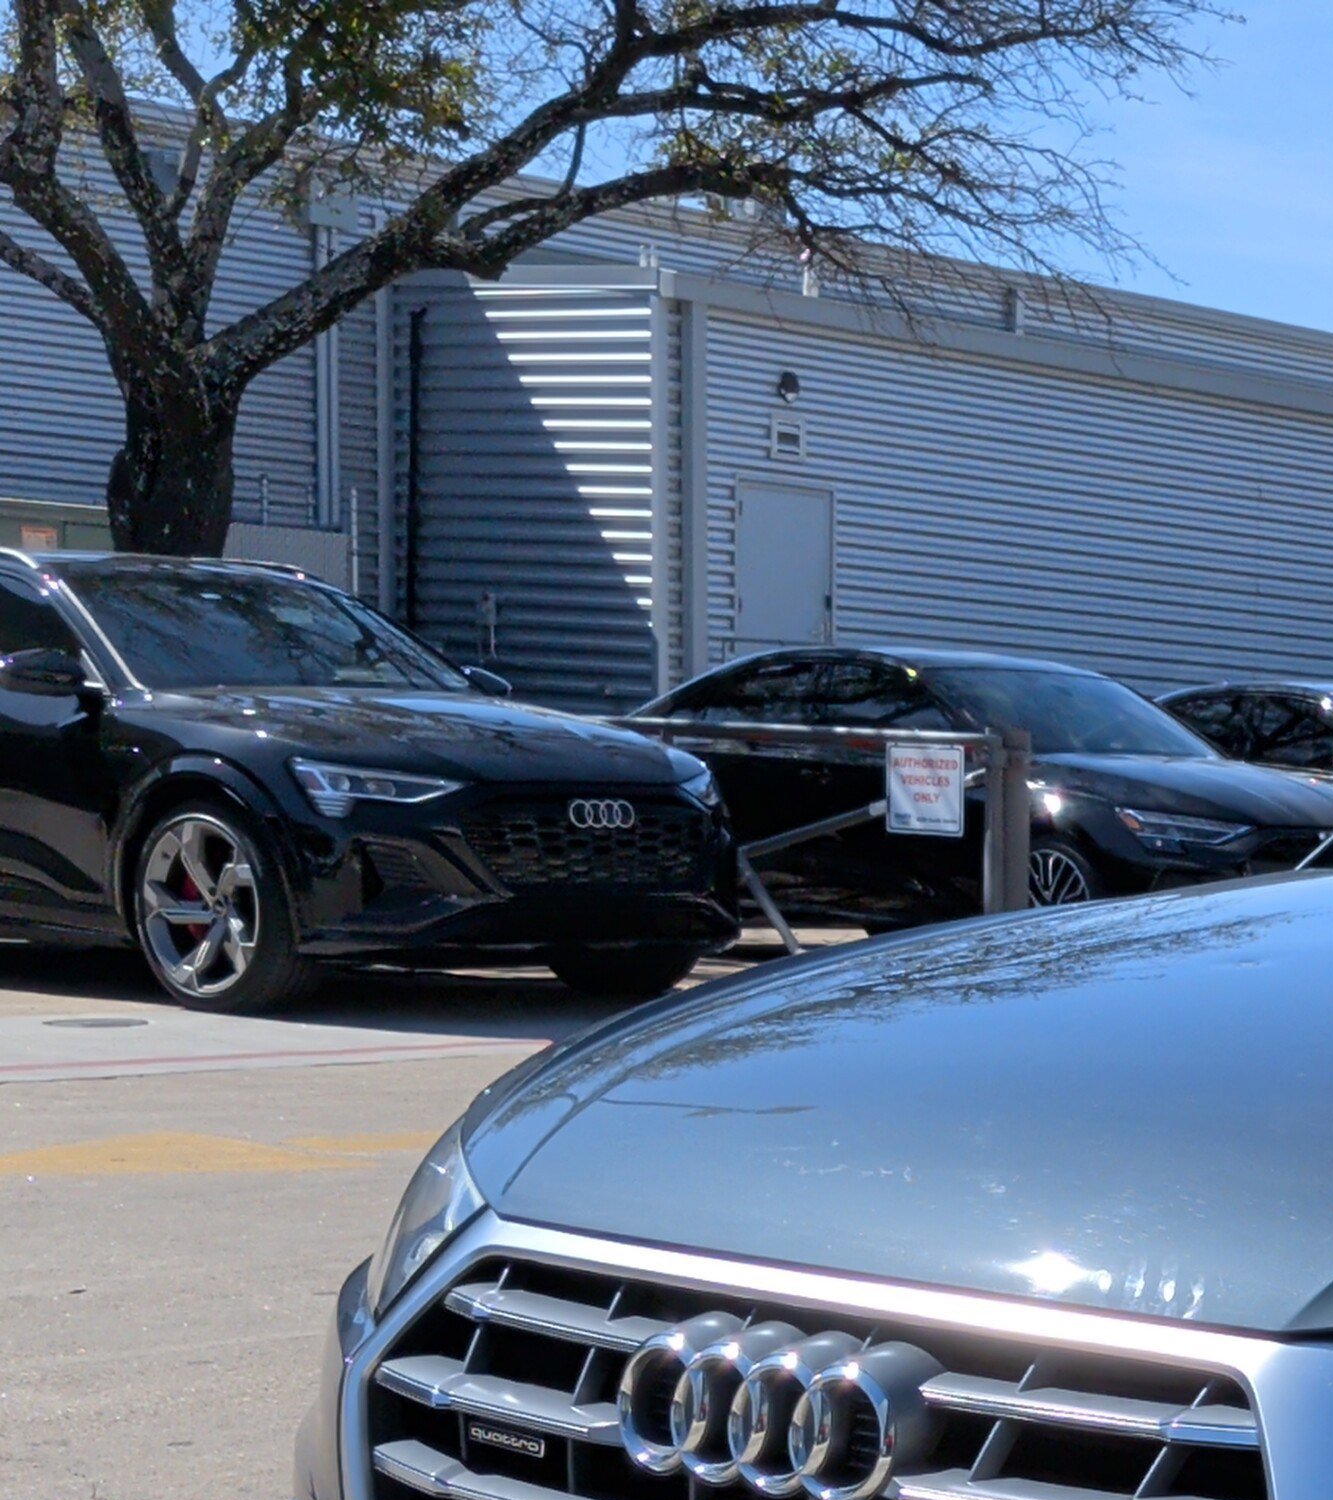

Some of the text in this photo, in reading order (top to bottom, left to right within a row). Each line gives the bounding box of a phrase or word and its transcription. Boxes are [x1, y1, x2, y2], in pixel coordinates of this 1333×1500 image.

[893, 757, 958, 770] AUTHORIZED
[901, 775, 950, 787] VEHICLES
[913, 792, 940, 804] ONLY
[470, 1427, 540, 1452] quattro
